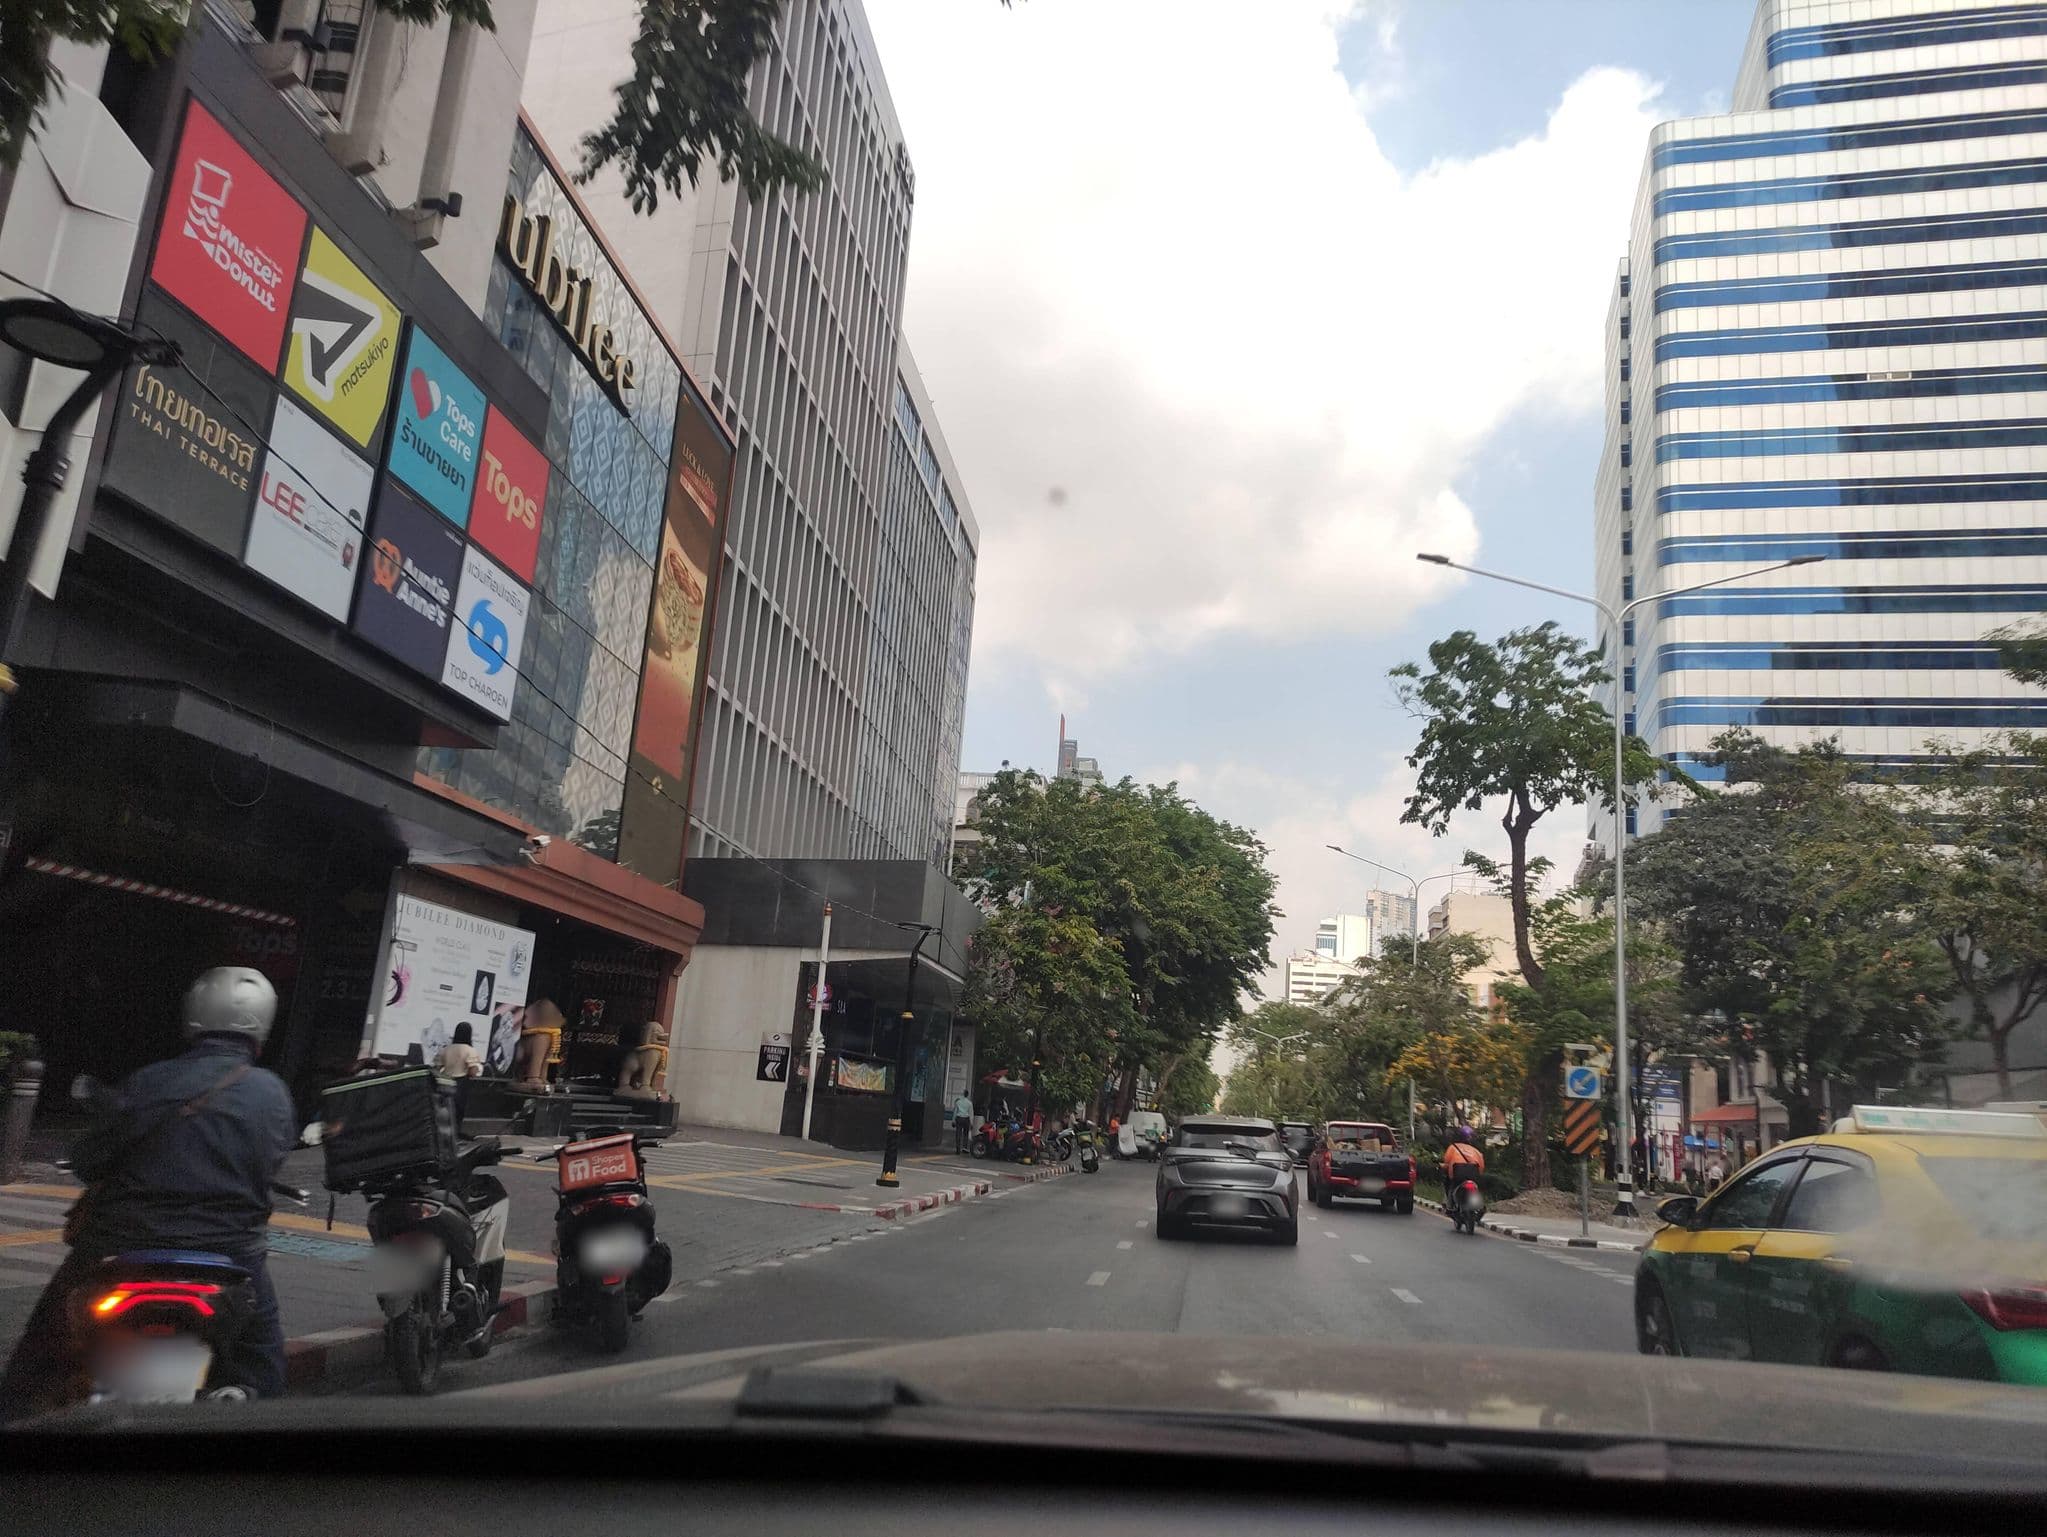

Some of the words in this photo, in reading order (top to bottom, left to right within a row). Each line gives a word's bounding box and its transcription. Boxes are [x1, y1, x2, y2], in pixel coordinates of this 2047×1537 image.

[214, 244, 276, 312] Donut
[505, 194, 636, 408] ubilee
[340, 337, 389, 396] matsukiyo
[445, 394, 476, 438] Tops
[131, 403, 171, 439] THAI
[180, 436, 249, 491] TERRACE
[401, 417, 466, 493] ร้านขายยา
[440, 421, 472, 462] Care
[261, 470, 306, 527] LEE
[485, 450, 538, 530] Tops
[400, 557, 451, 606] Auntie
[450, 663, 468, 684] TOP
[469, 676, 508, 709] CHAROEN
[455, 916, 506, 941] DIAMOND
[763, 1046, 787, 1055] PARKING
[591, 1154, 625, 1165] Shopee
[592, 1161, 627, 1178] Food
